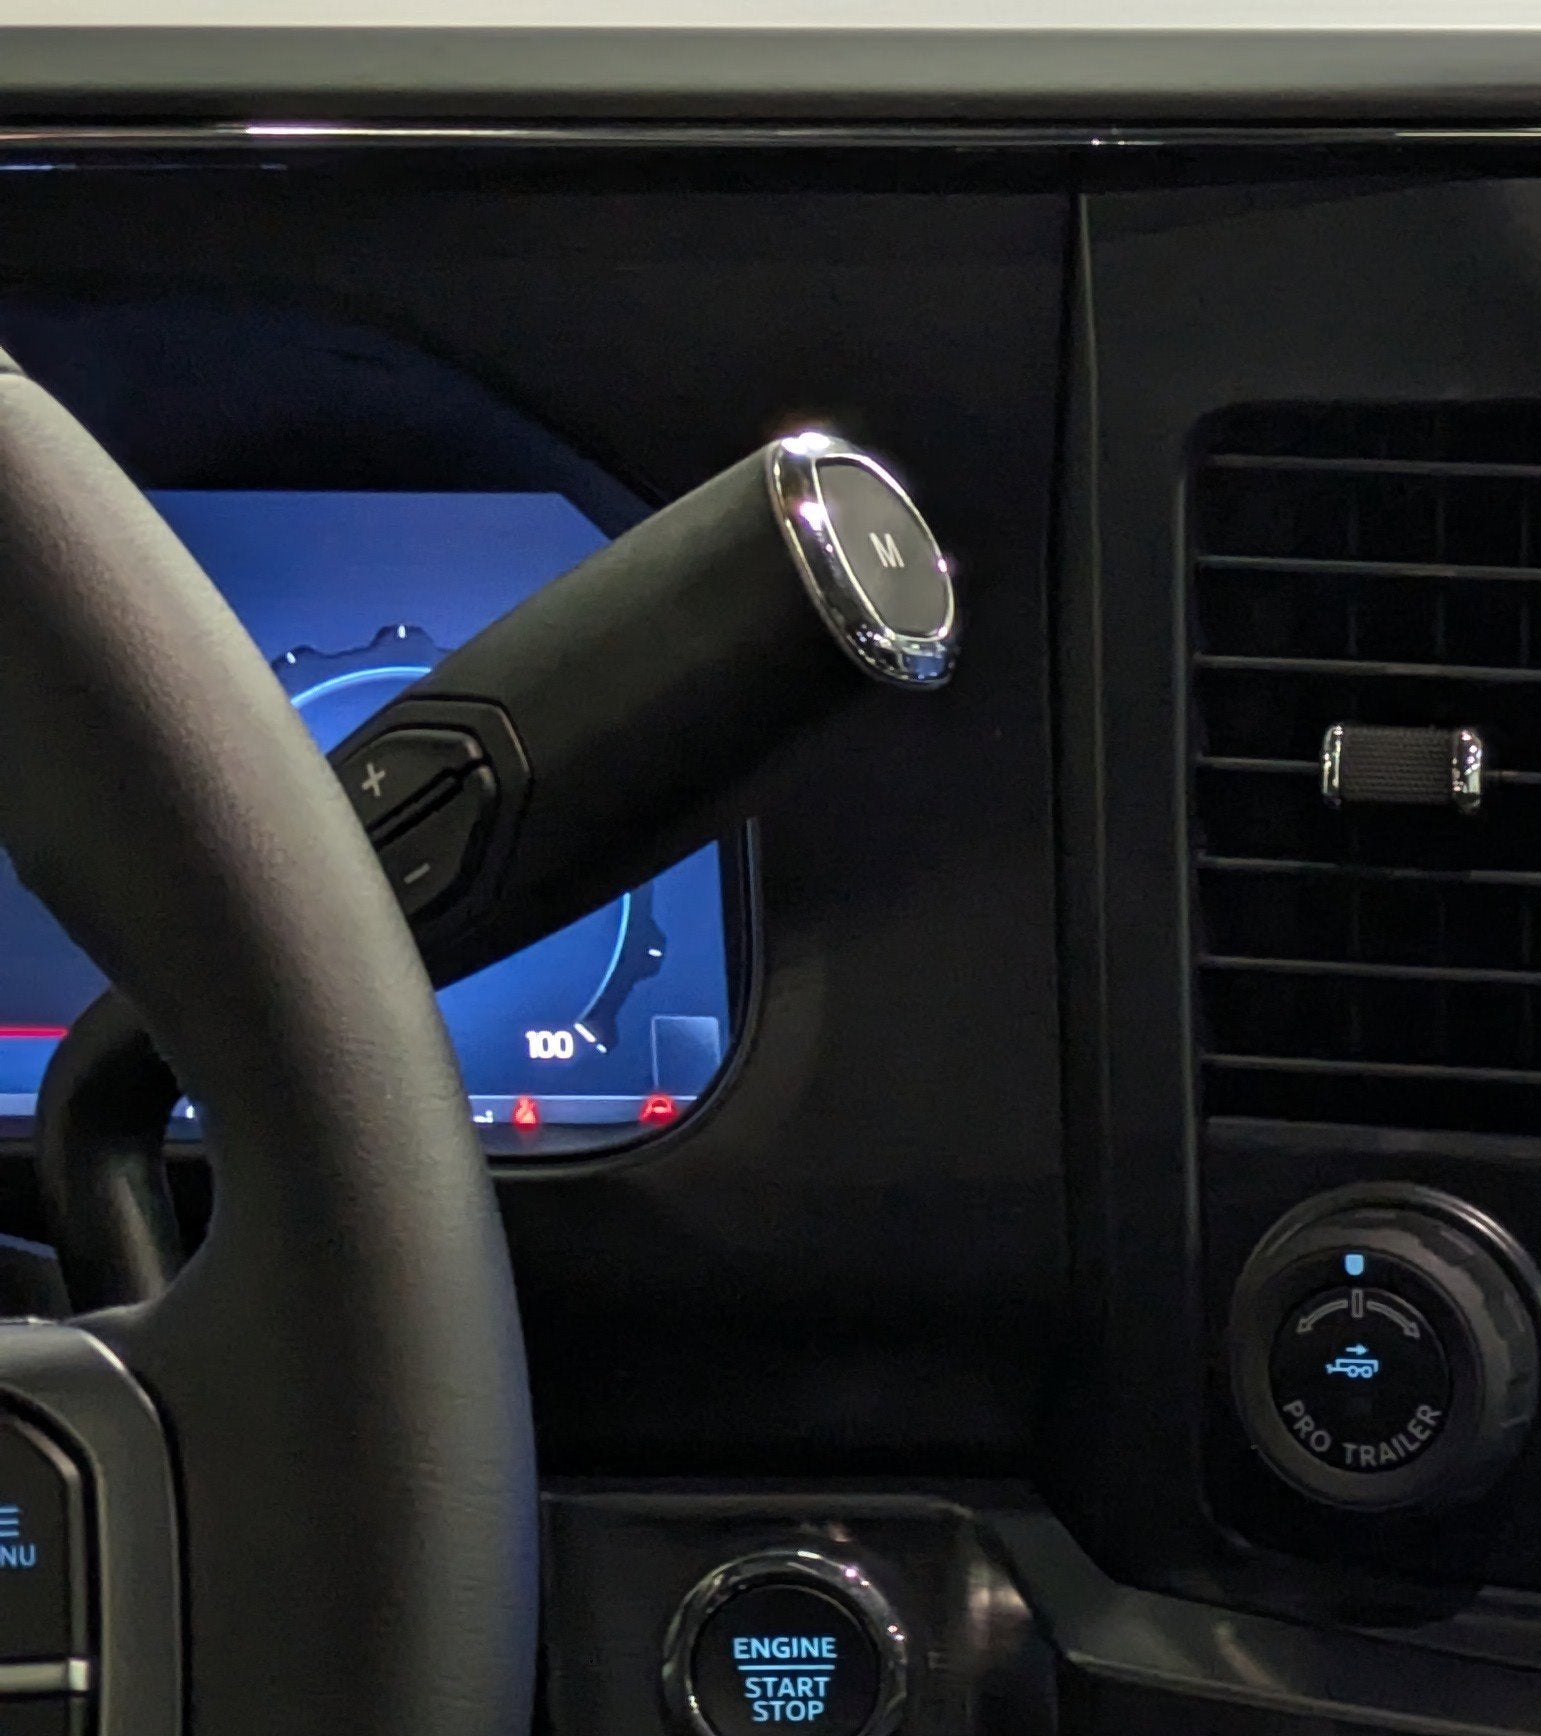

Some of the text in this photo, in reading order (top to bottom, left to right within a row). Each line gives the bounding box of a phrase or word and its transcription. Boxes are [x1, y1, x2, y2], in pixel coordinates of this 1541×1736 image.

[872, 532, 905, 568] M
[525, 1029, 573, 1060] 100
[1282, 1400, 1443, 1468] PRO TRAILER
[733, 1636, 838, 1660] ENGINE
[744, 1676, 830, 1699] START
[752, 1700, 825, 1722] STOP
